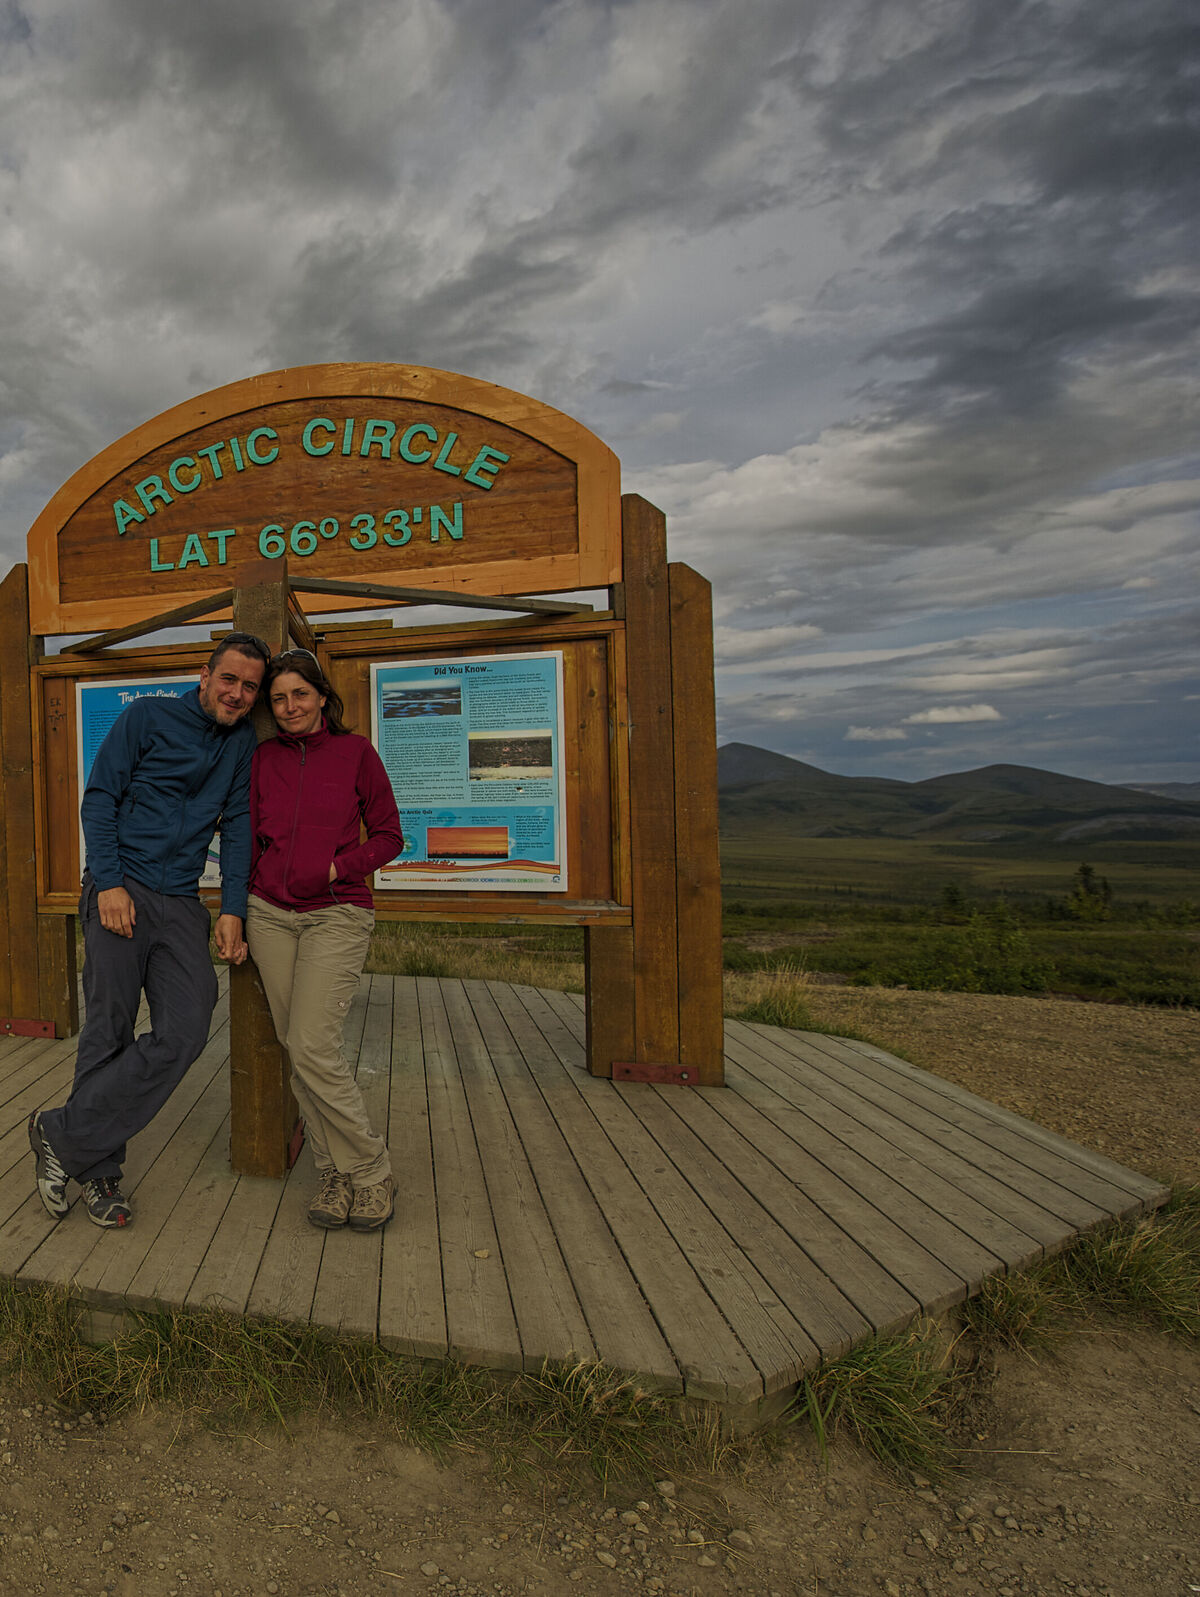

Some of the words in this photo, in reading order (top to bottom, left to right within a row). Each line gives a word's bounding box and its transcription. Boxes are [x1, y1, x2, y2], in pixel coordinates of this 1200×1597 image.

[112, 426, 280, 535] ARCTIC
[301, 417, 510, 491] CIRCLE
[150, 528, 236, 572] LAT
[434, 667, 446, 675] Did
[448, 666, 463, 674] You
[117, 691, 134, 705] The
